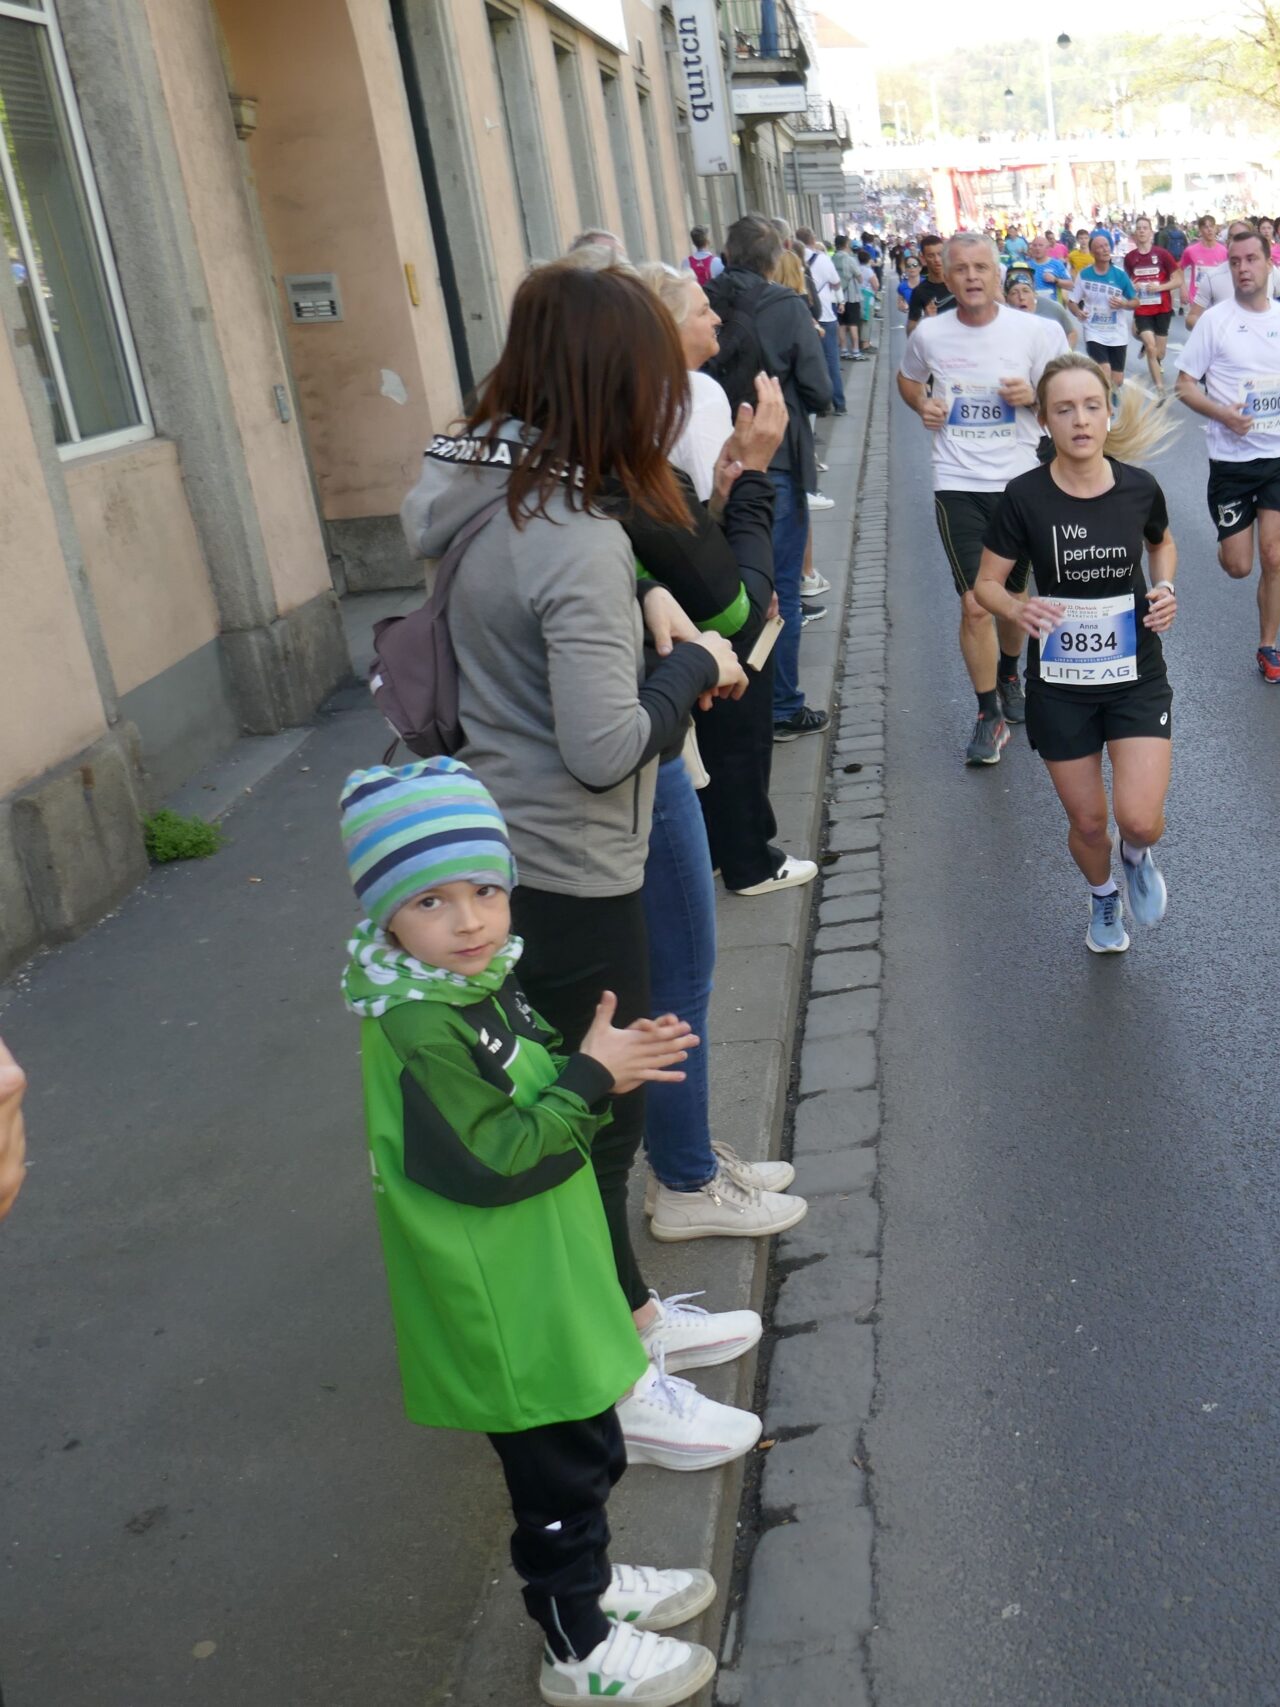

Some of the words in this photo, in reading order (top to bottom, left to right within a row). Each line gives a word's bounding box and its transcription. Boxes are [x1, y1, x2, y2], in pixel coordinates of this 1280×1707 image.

[679, 16, 715, 123] quitch
[960, 404, 1003, 419] 8786
[951, 427, 986, 439] LINZ
[989, 428, 1012, 438] AG
[1061, 524, 1088, 540] We
[1063, 545, 1127, 565] perform
[1064, 563, 1134, 583] together!
[1060, 631, 1118, 652] 9834
[1046, 666, 1096, 680] LINZ
[1101, 665, 1130, 679] AG
